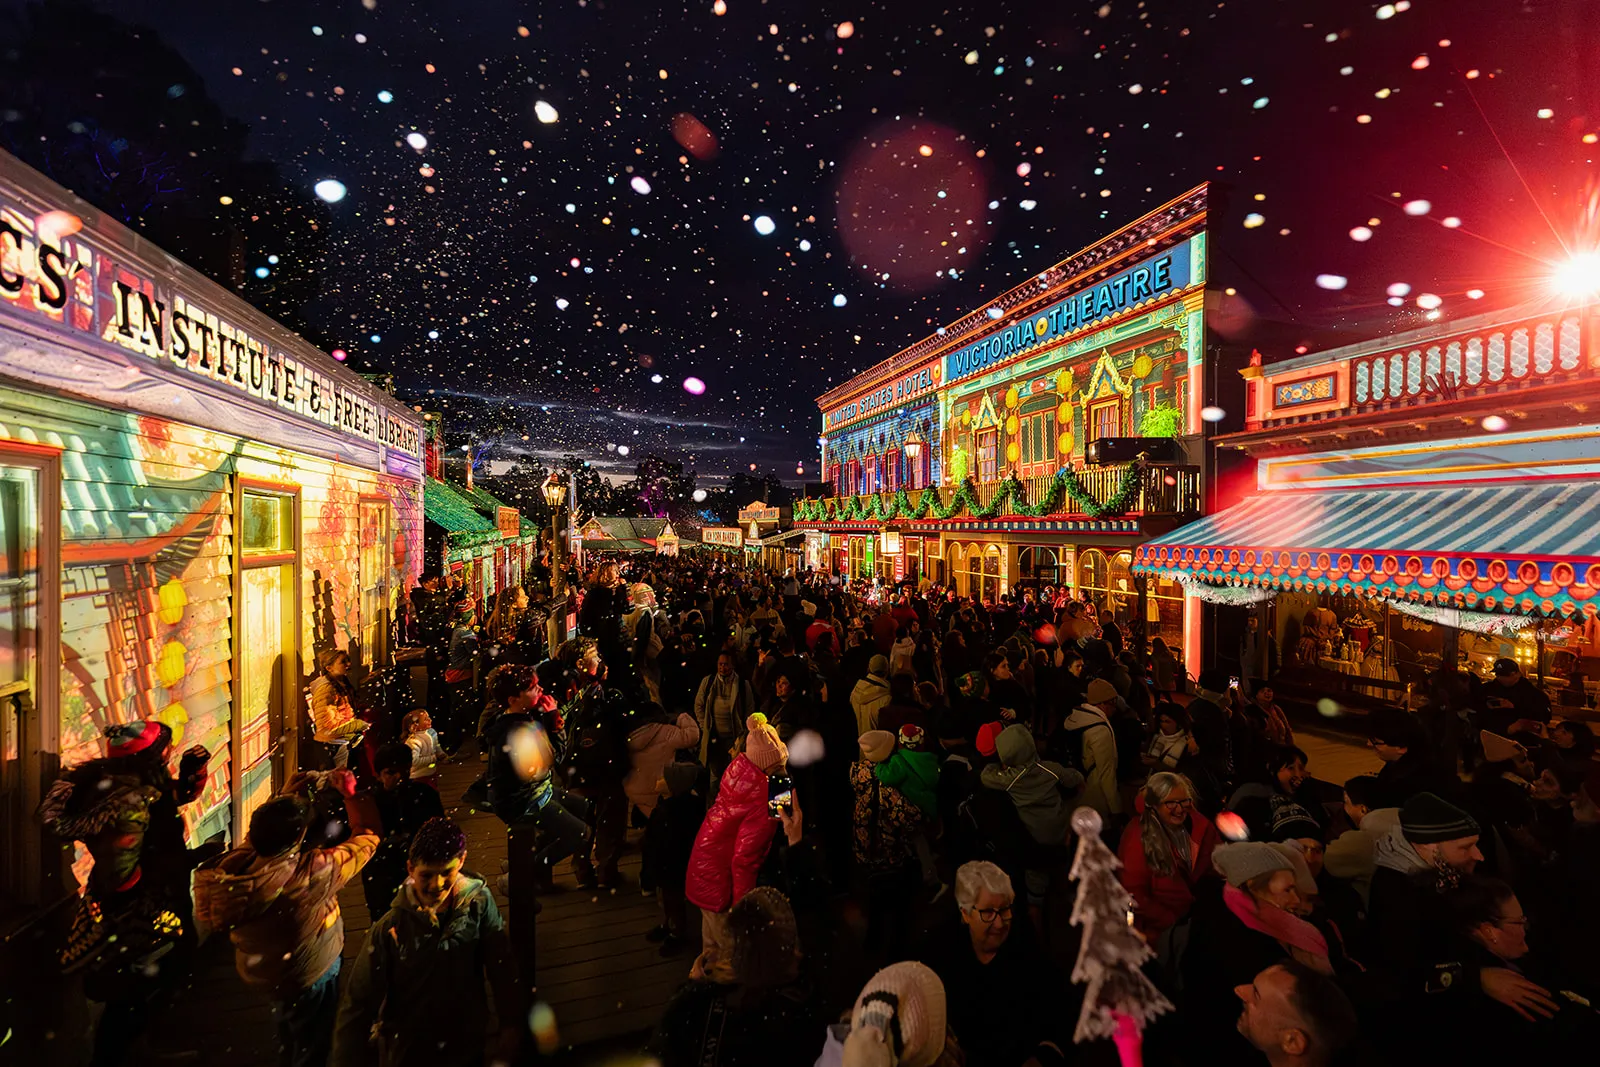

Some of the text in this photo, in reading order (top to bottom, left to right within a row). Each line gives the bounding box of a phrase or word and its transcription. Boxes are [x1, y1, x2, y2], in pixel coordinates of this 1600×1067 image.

[115, 280, 296, 404] INSTITUTE
[310, 380, 321, 414] &
[334, 391, 370, 434] FREE
[378, 414, 419, 454] LIBRARY
[955, 256, 1173, 375] VICTORIA THEATRE
[830, 366, 933, 426] UNITED STATES HOTEL
